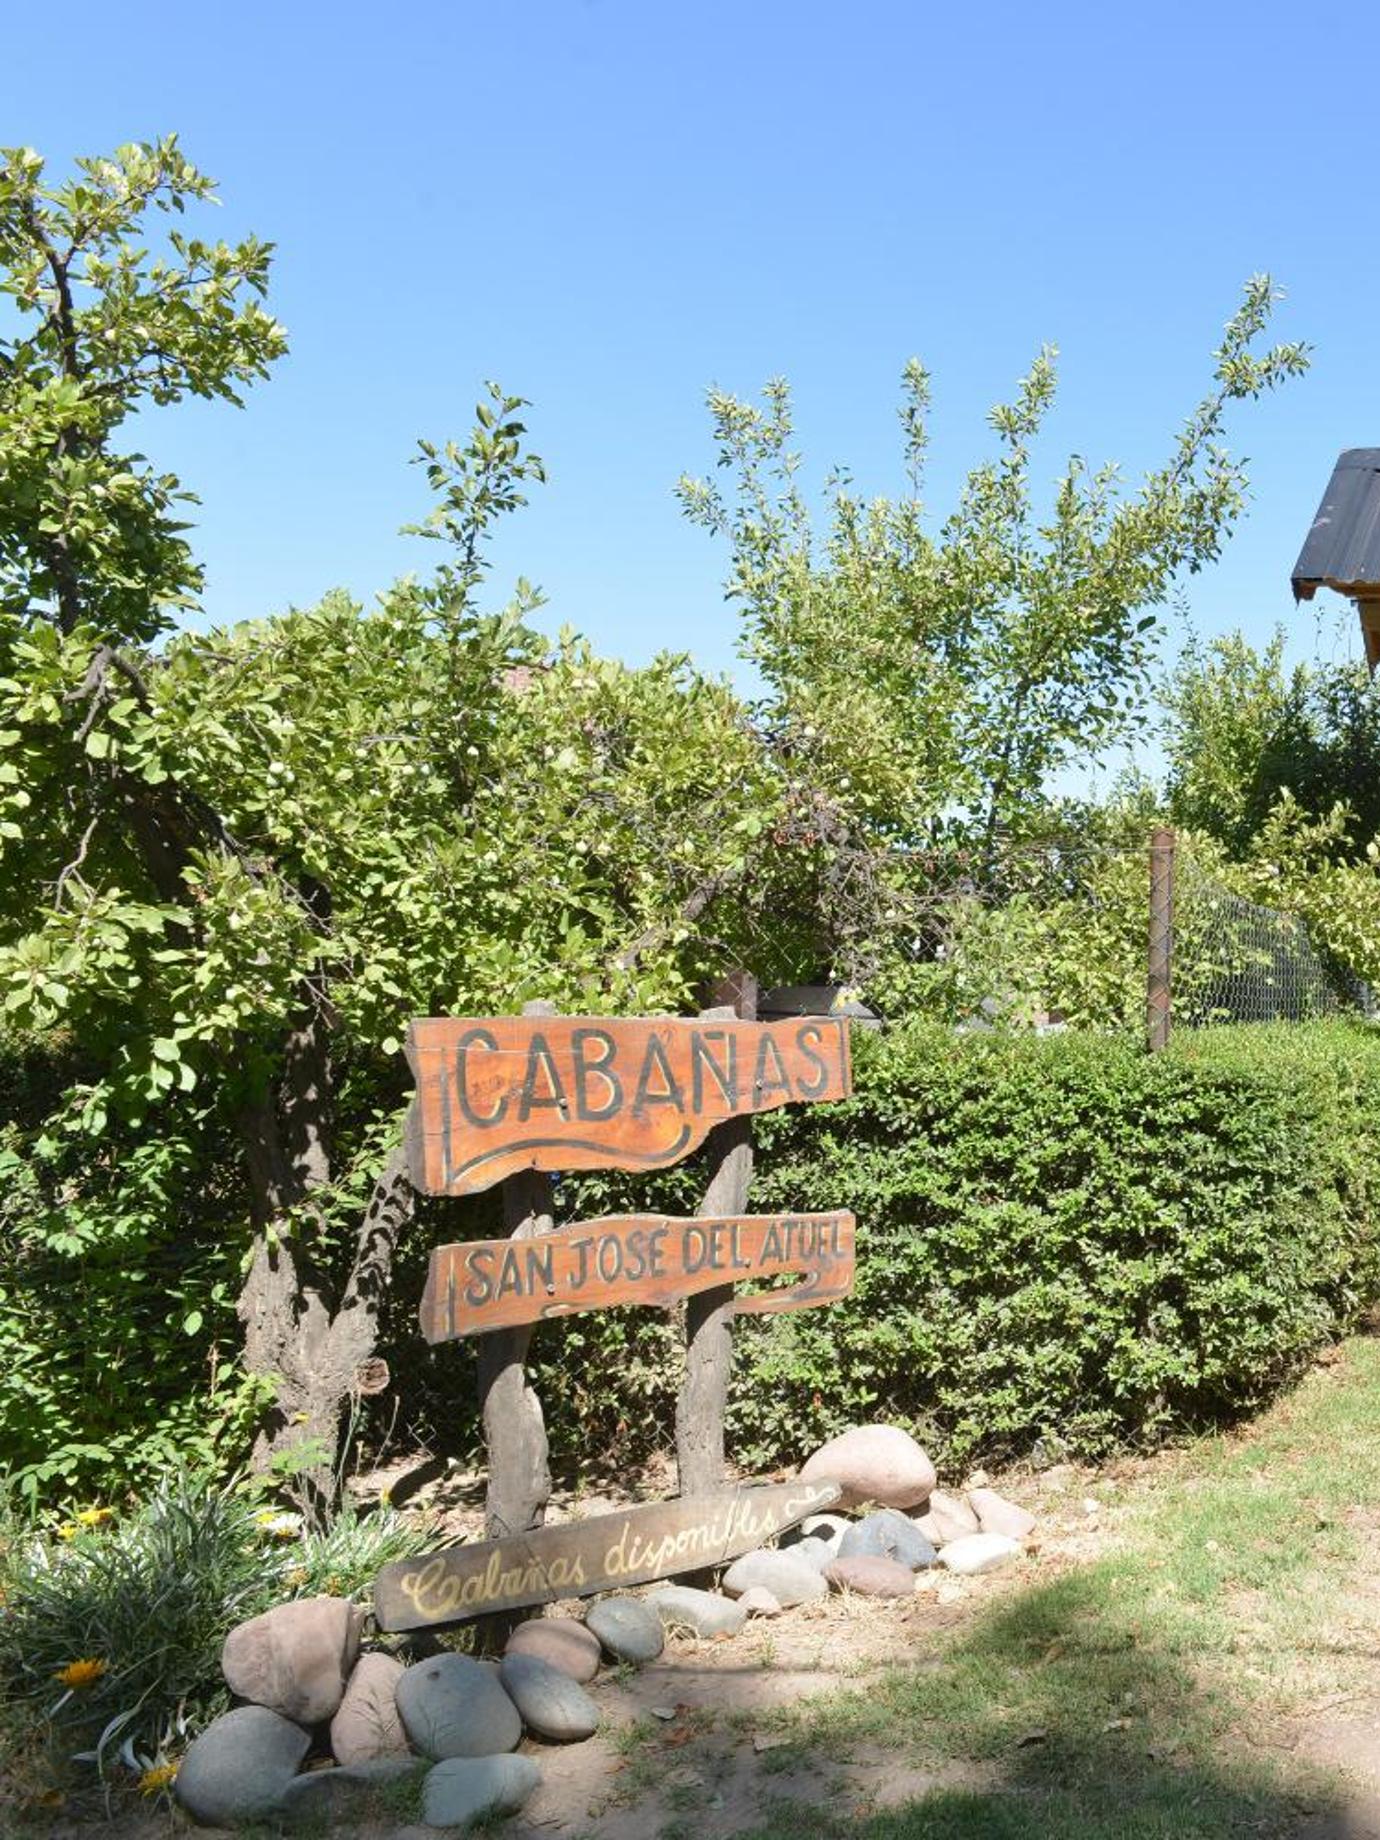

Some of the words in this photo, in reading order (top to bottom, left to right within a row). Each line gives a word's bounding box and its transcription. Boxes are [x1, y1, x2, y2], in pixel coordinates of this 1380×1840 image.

[456, 1025, 828, 1128] CABAÑAS
[464, 1249, 554, 1306] SAN
[681, 1225, 750, 1274] DEL
[759, 1219, 845, 1266] ATUEL
[401, 1550, 586, 1618] Cabañas
[603, 1499, 779, 1577] disponibles
